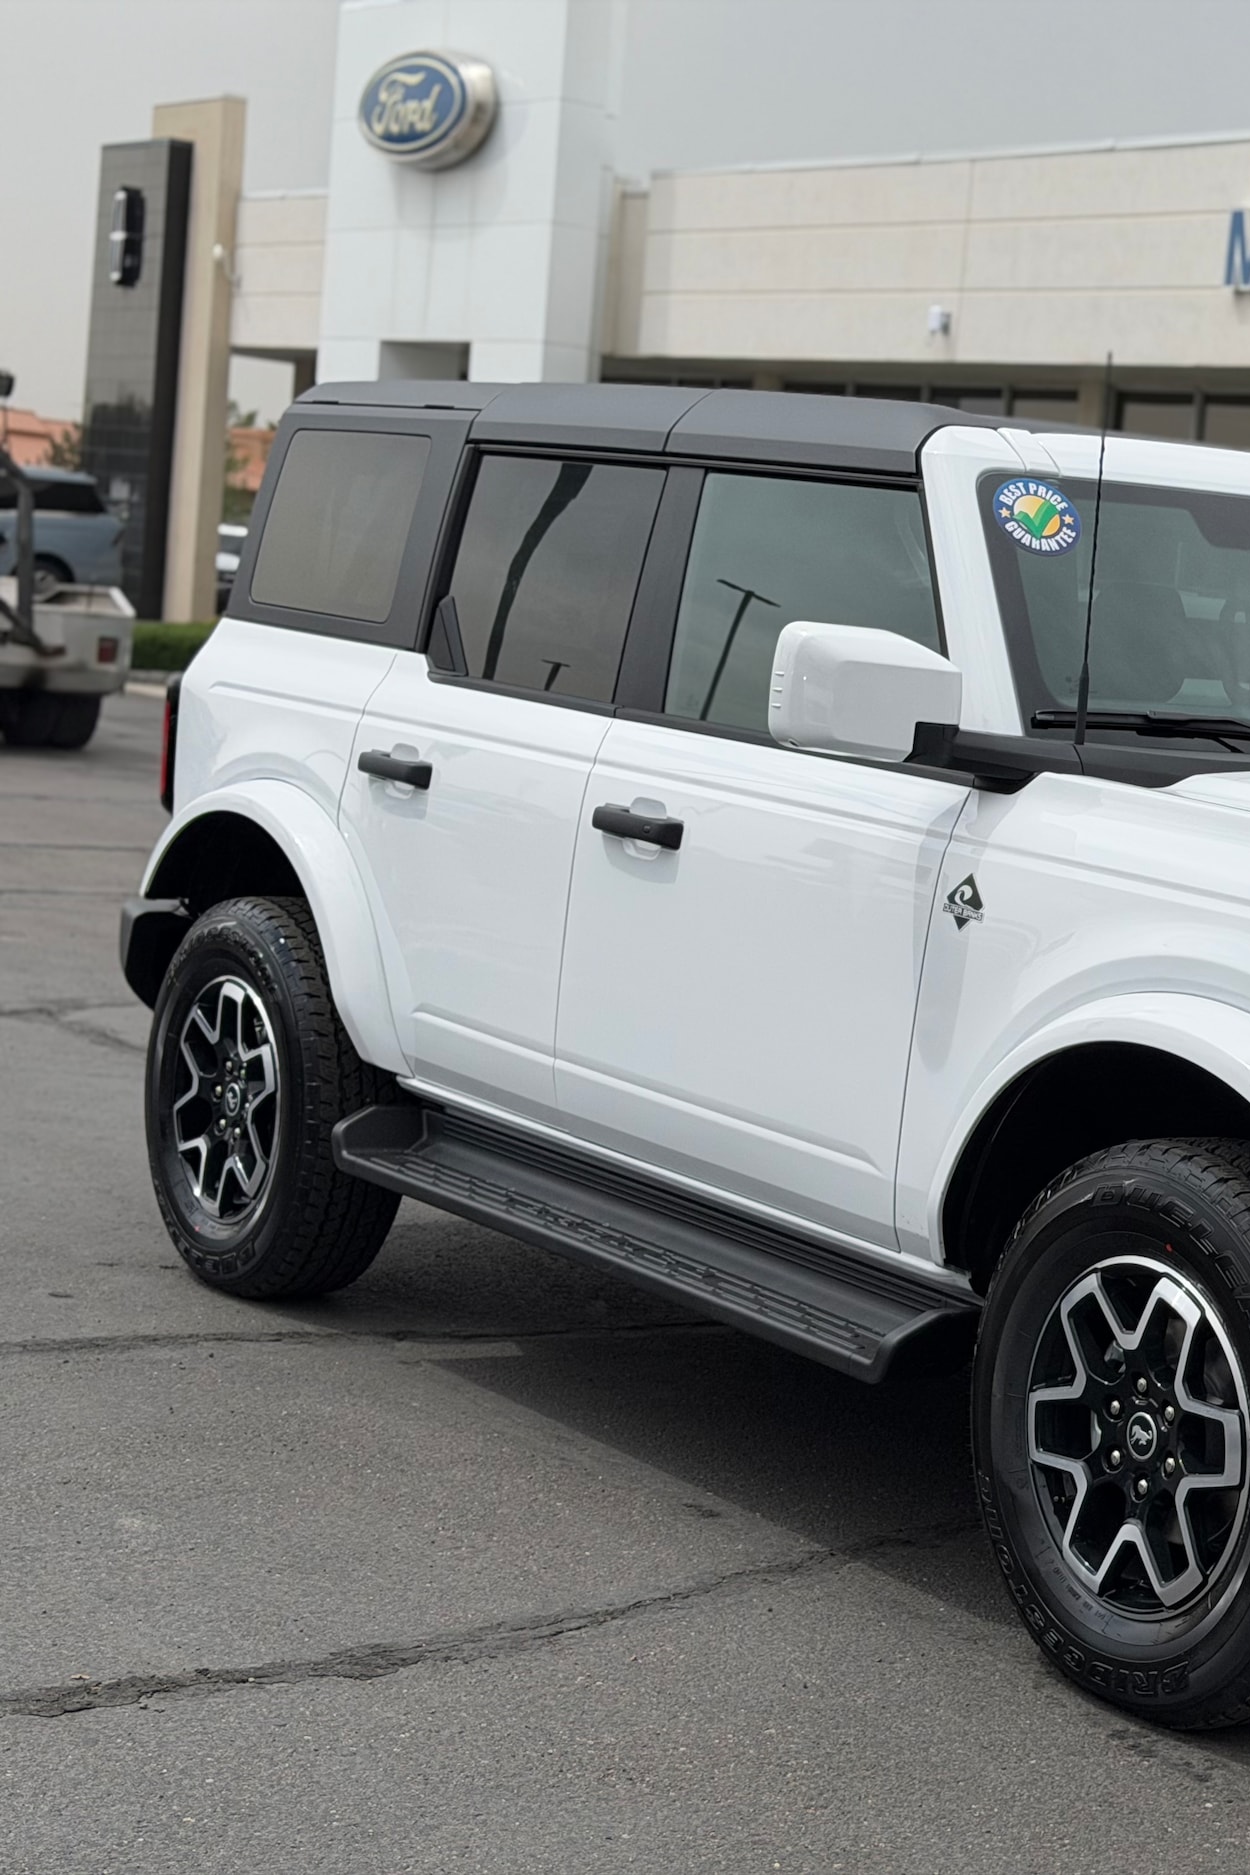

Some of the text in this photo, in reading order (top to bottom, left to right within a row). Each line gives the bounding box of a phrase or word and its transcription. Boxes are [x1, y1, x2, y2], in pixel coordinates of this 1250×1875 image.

[371, 71, 442, 136] Ford
[998, 482, 1069, 511] BEST PRICE
[1004, 520, 1077, 552] GUARANTEE
